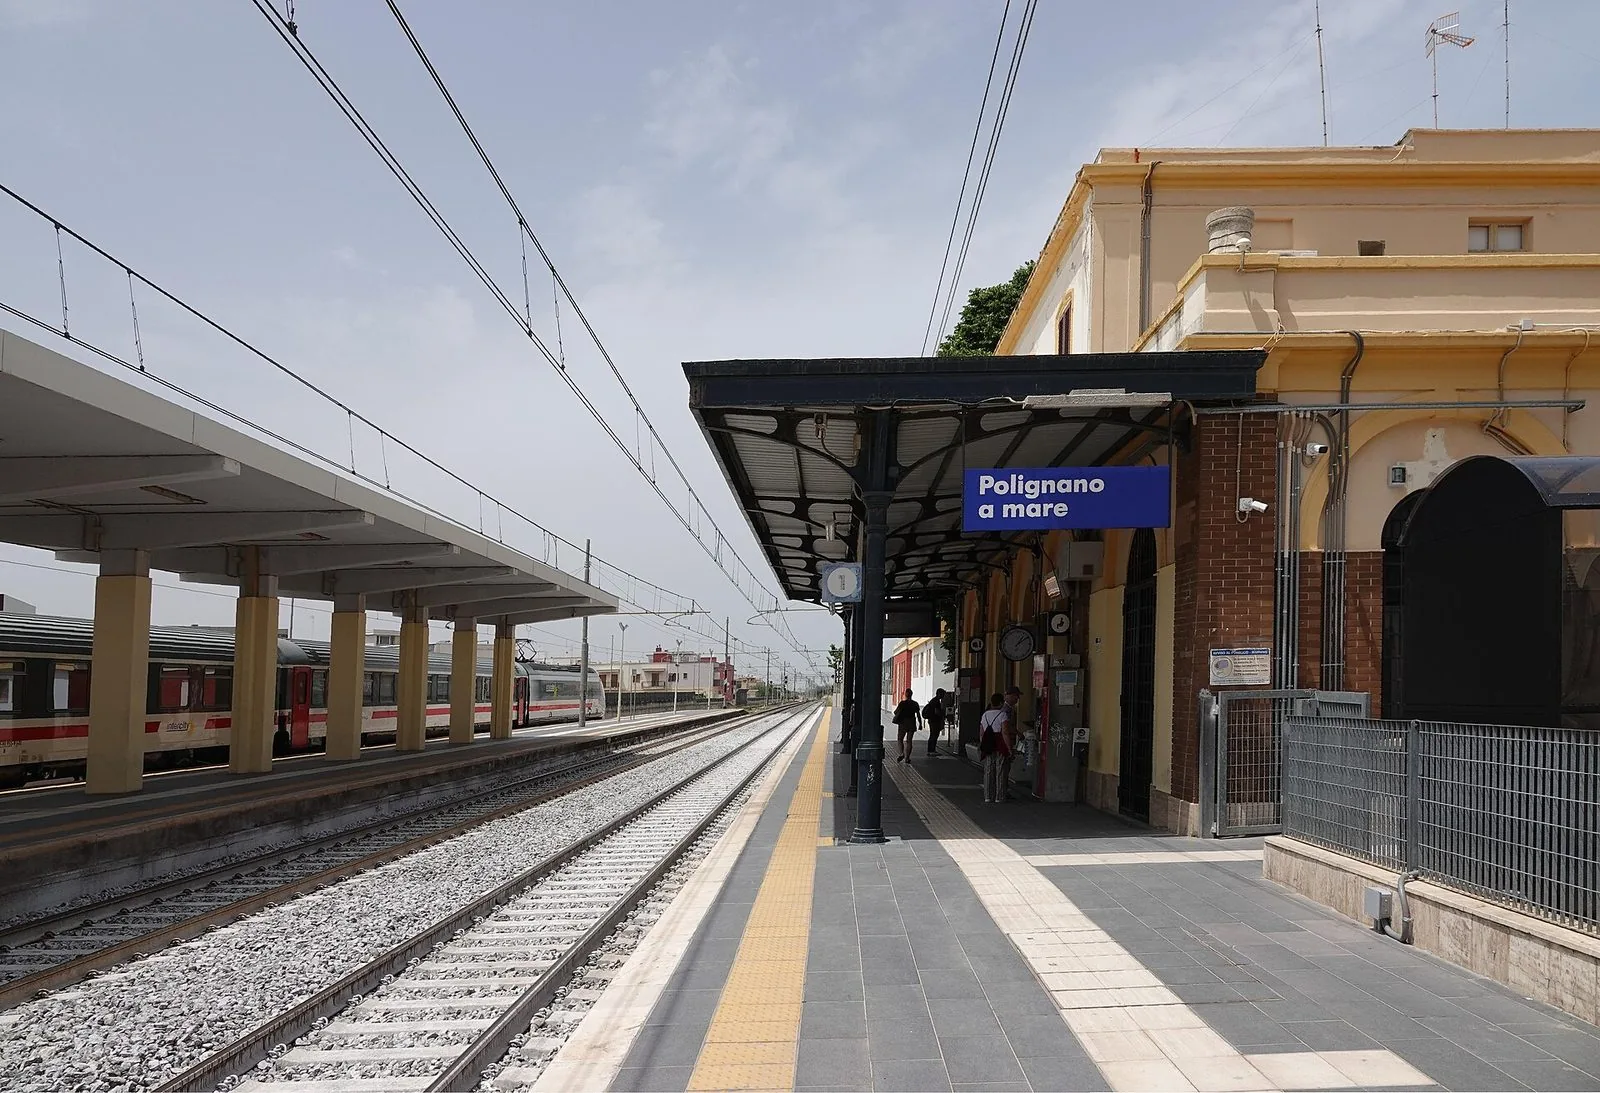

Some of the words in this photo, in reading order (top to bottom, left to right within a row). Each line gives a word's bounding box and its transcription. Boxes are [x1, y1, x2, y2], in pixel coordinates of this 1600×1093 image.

[978, 474, 1105, 499] Polignano
[978, 503, 994, 519] a
[1002, 502, 1069, 518] mare
